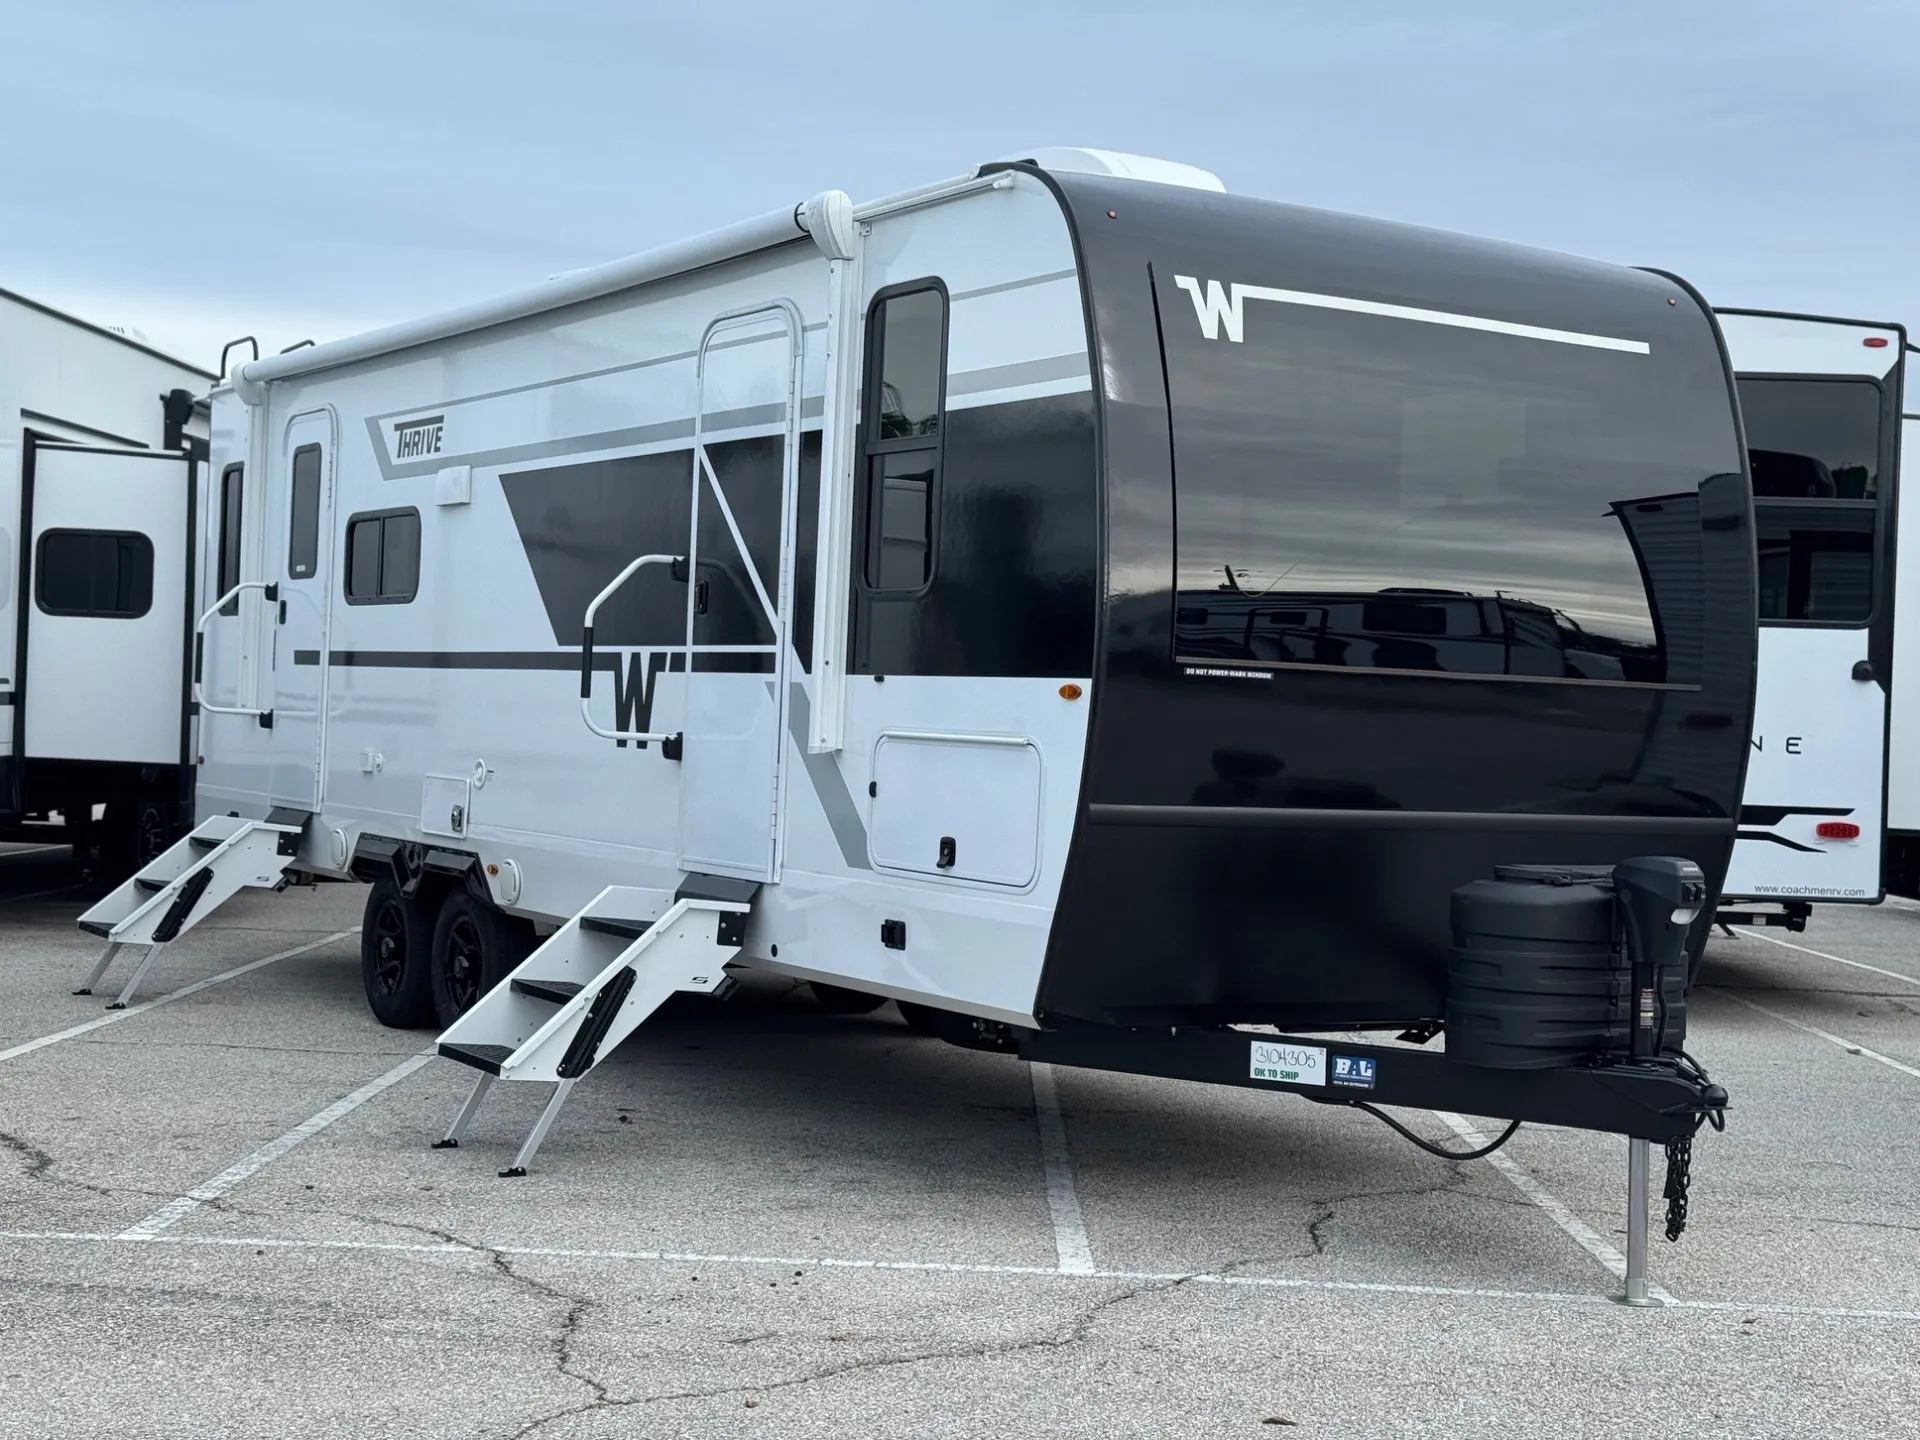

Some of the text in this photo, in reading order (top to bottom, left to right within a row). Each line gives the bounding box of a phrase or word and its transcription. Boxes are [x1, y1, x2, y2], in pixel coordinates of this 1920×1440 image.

[394, 415, 445, 459] THRIVE
[1186, 667, 1195, 675] DO
[1195, 668, 1207, 676] NOT
[1247, 671, 1272, 679] WINDOW
[1754, 885, 1865, 897] www.coachmenrv.com
[1255, 1045, 1316, 1069] 3104305
[1254, 1067, 1299, 1081] OK TO SHIP
